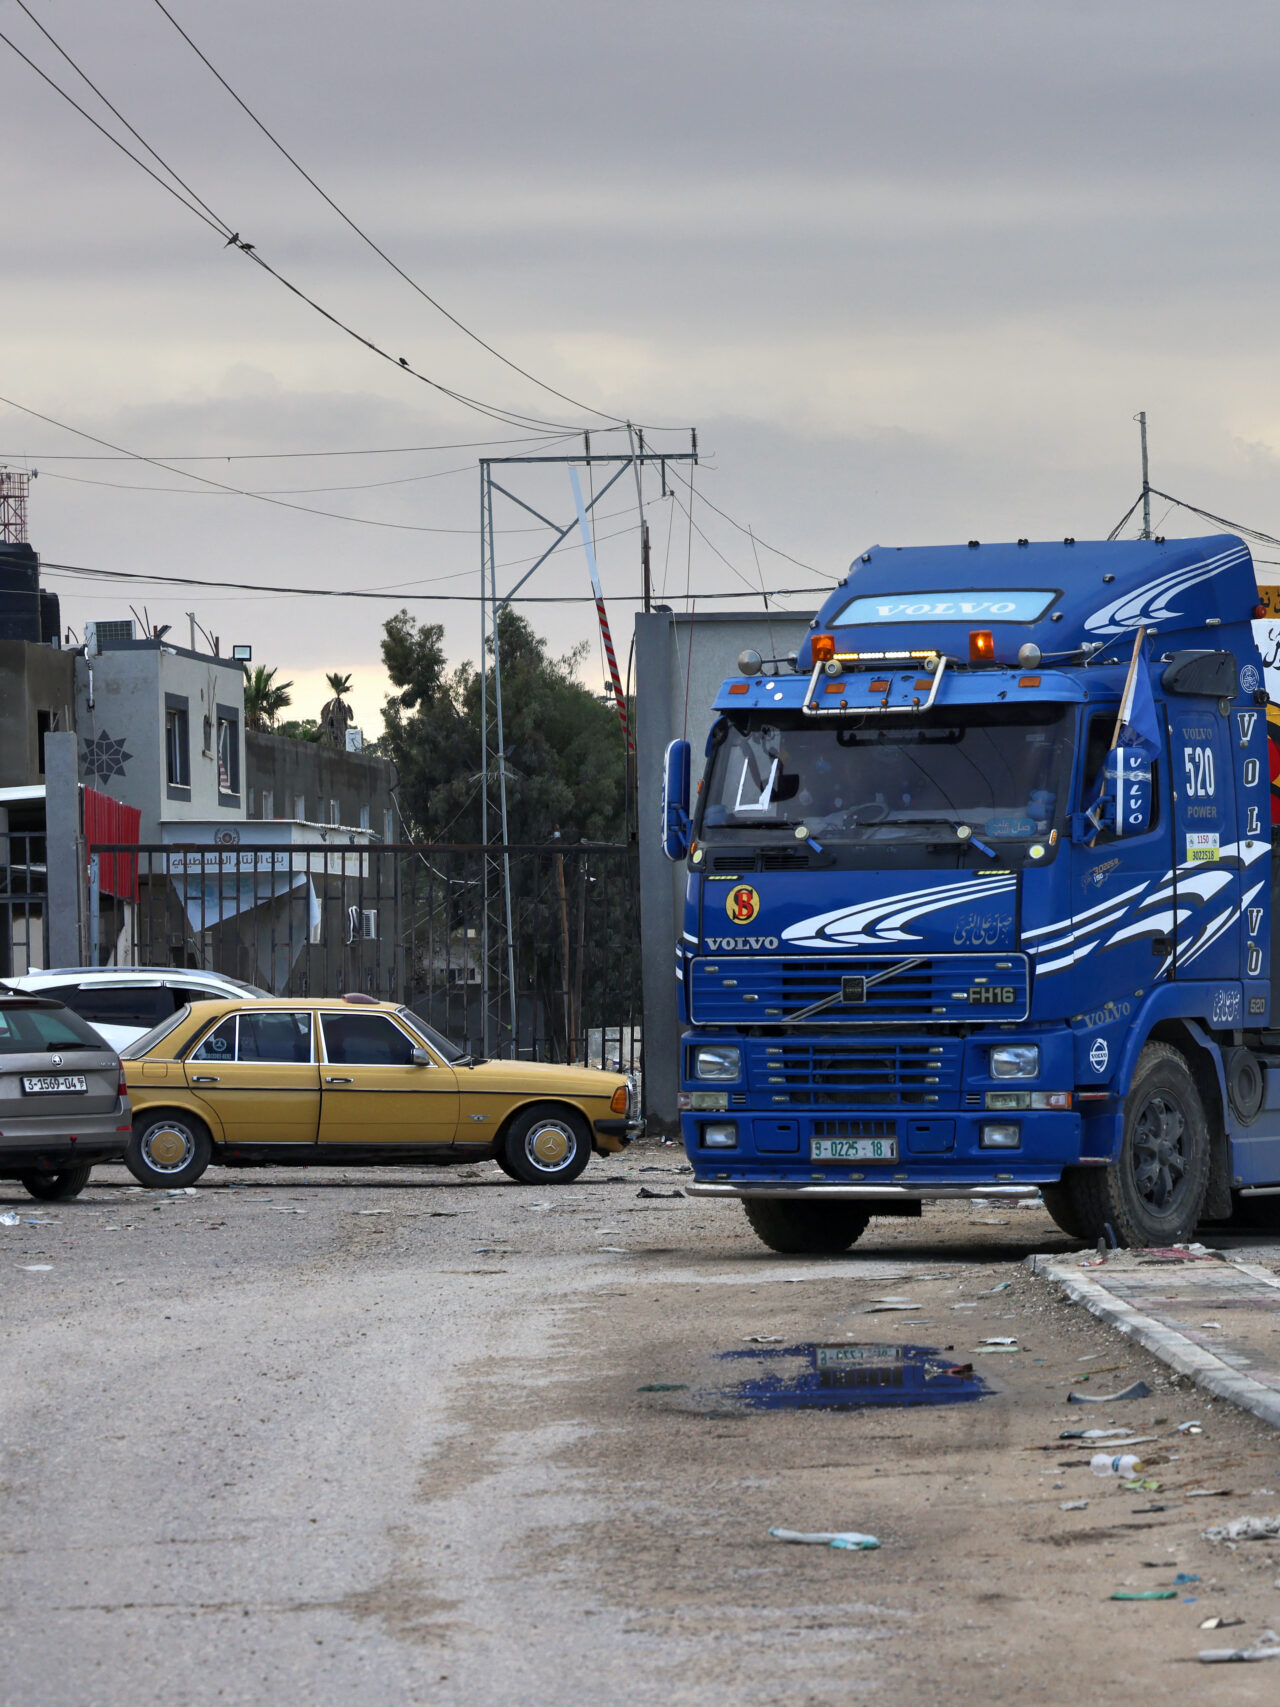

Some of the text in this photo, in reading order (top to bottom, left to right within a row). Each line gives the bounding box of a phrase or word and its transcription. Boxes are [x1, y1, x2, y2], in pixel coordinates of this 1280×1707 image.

[876, 602, 1016, 616] VOLVO
[1182, 728, 1213, 740] VOLVO
[1184, 747, 1215, 797] 520
[1129, 757, 1143, 824] VOLVO
[1187, 806, 1217, 818] POWER
[1197, 835, 1210, 844] 1150
[1237, 712, 1263, 976] VOLVO
[705, 936, 779, 950] VOLVO
[969, 987, 1014, 1003] FH16
[1250, 999, 1265, 1013] 520
[1083, 1001, 1131, 1028] VOLVO
[27, 1078, 76, 1090] 3-1569-04
